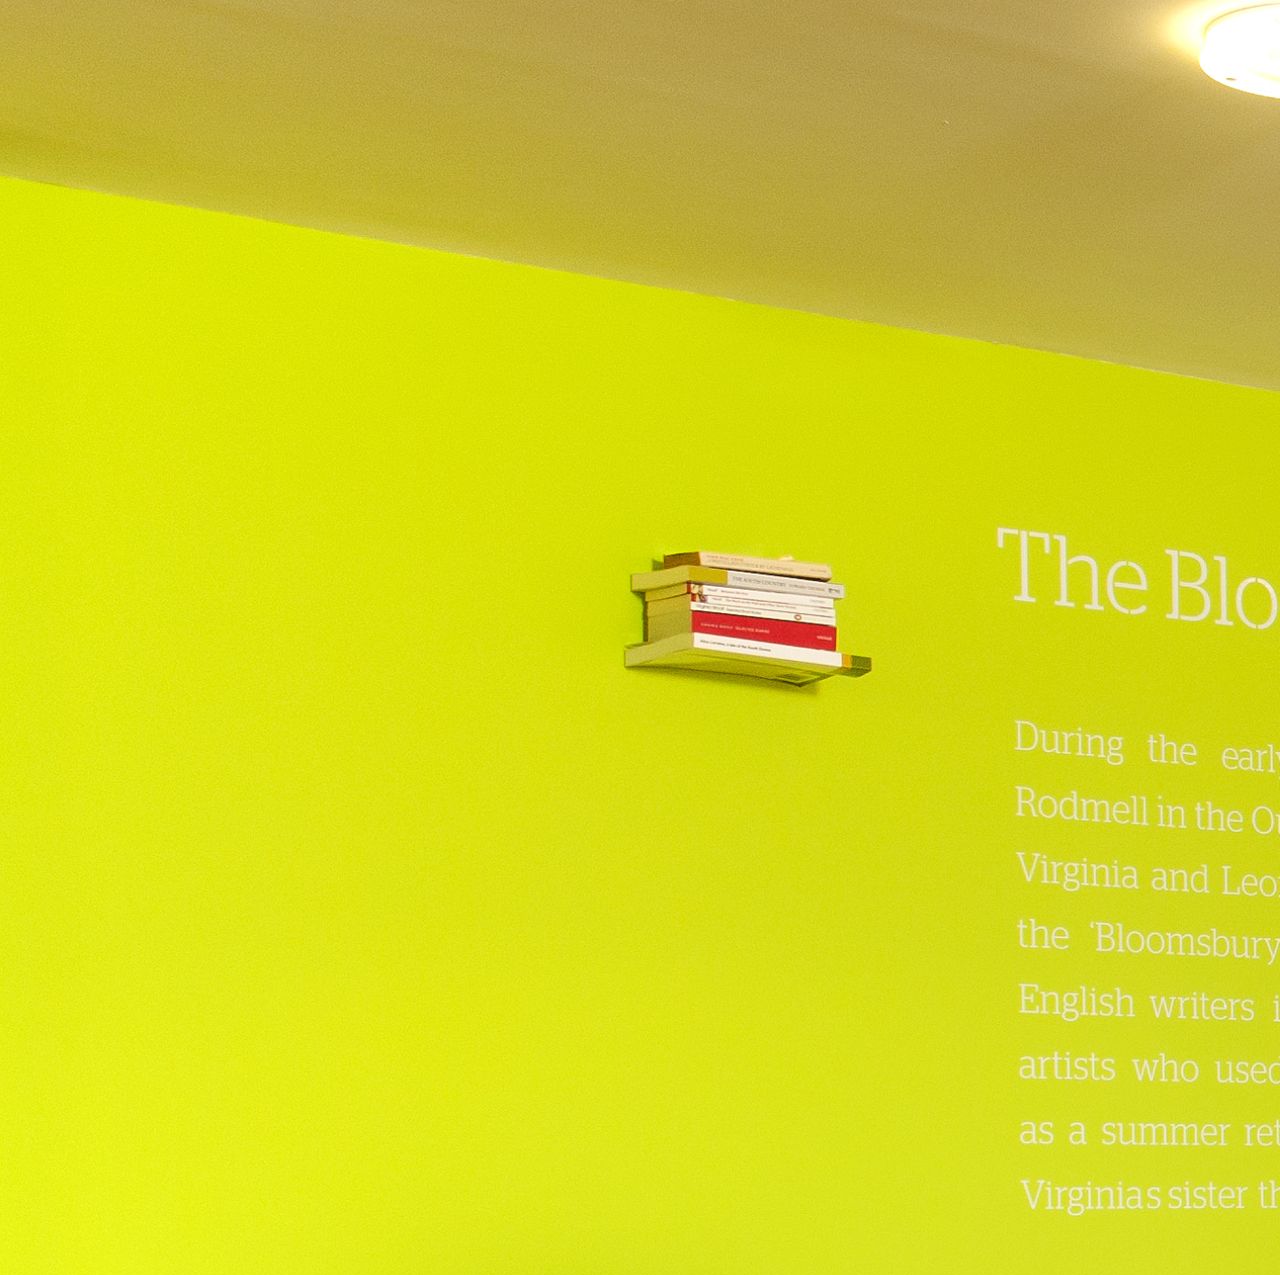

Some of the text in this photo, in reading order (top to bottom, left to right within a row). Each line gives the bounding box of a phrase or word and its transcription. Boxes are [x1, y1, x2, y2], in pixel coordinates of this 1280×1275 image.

[997, 527, 1148, 615] The
[1014, 719, 1125, 766] During
[1147, 733, 1198, 766] the
[1015, 785, 1149, 826] Rodmell
[1157, 796, 1187, 829] in
[1195, 801, 1244, 832] the
[1016, 851, 1139, 892] Virginia
[1151, 864, 1210, 893] and
[1017, 918, 1070, 950] the
[1019, 982, 1136, 1022] English
[1149, 992, 1255, 1022] writers
[1019, 1051, 1116, 1081] artists
[1132, 1052, 1200, 1083] who
[1019, 1121, 1054, 1145] as
[1069, 1122, 1088, 1145] a
[1101, 1121, 1231, 1146] summer
[1020, 1178, 1162, 1216] Virginias
[1168, 1181, 1248, 1209] sister
